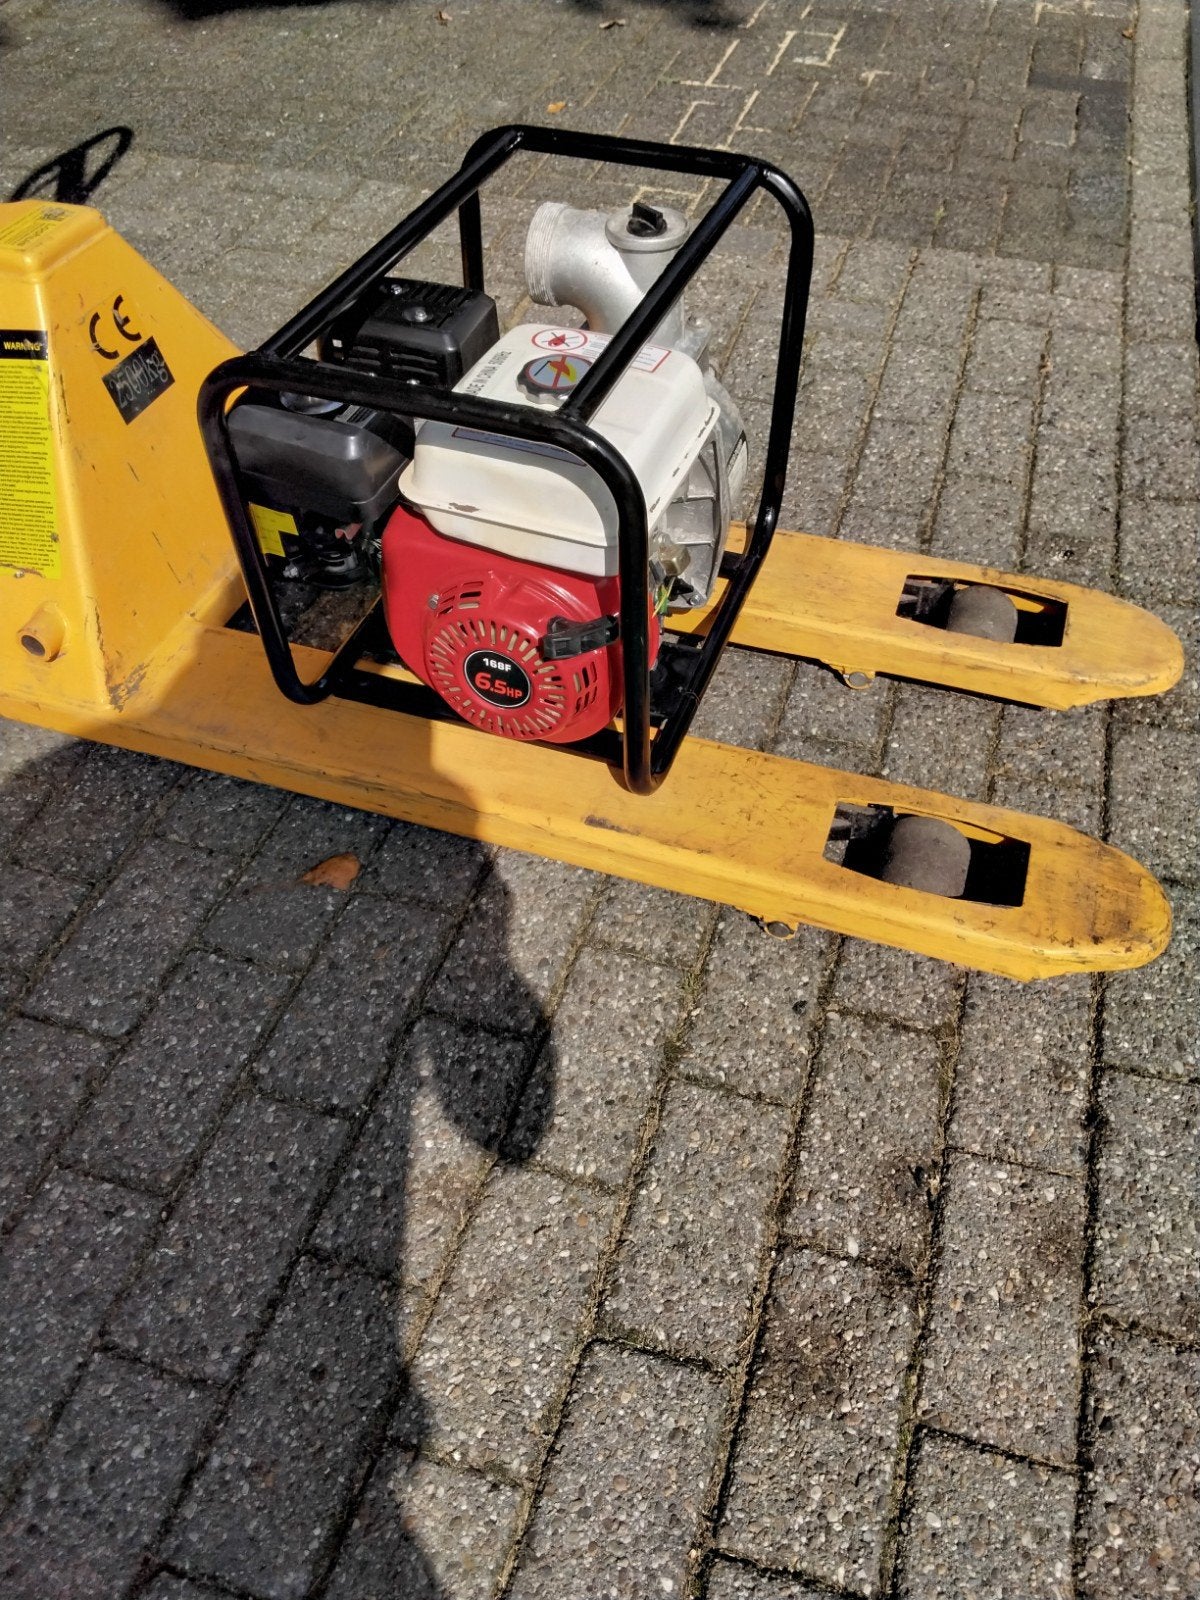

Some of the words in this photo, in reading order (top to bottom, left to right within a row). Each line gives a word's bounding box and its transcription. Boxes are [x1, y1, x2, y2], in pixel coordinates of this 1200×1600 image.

[89, 294, 142, 360] CE
[482, 657, 512, 672] 168F
[474, 671, 523, 699] 6.5HP
